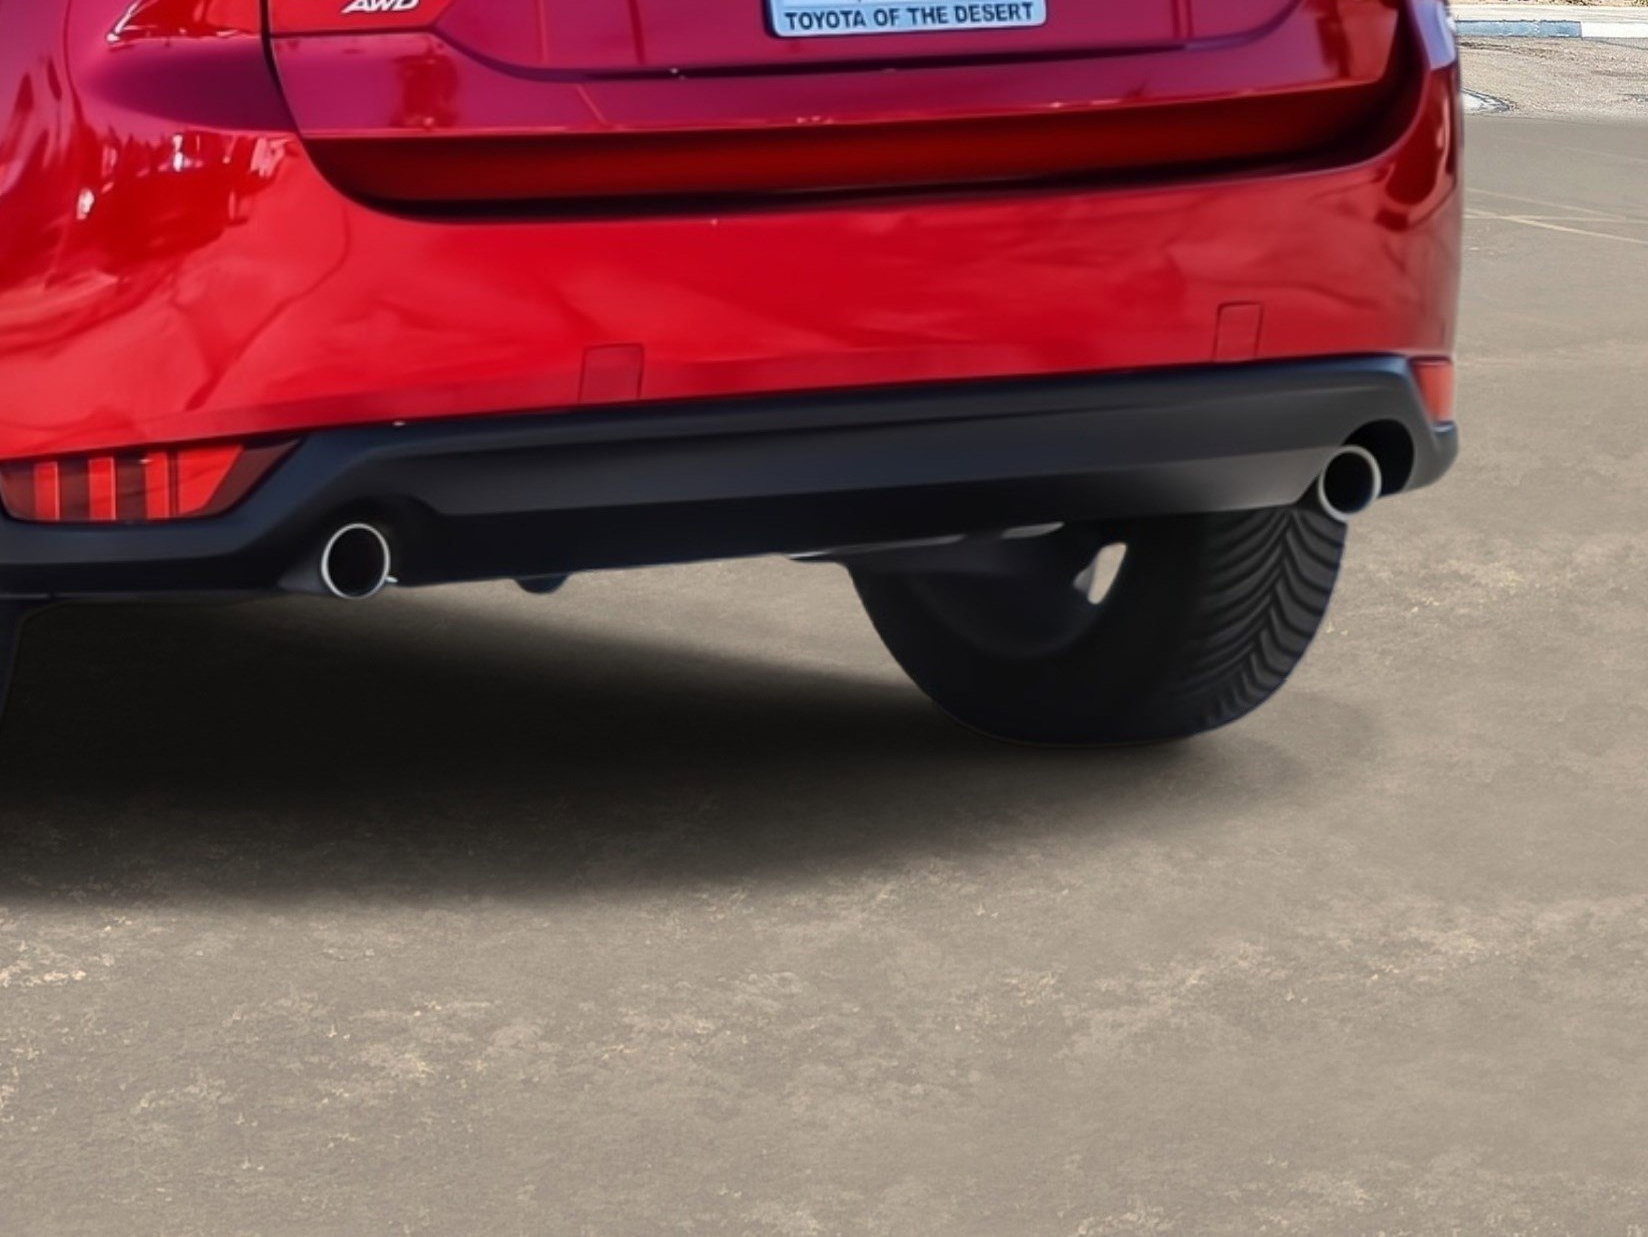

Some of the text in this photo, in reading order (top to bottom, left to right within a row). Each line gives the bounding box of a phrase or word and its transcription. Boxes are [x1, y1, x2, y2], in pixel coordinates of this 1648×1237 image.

[784, 2, 1034, 31] TOYOTA OF THE DESERT
